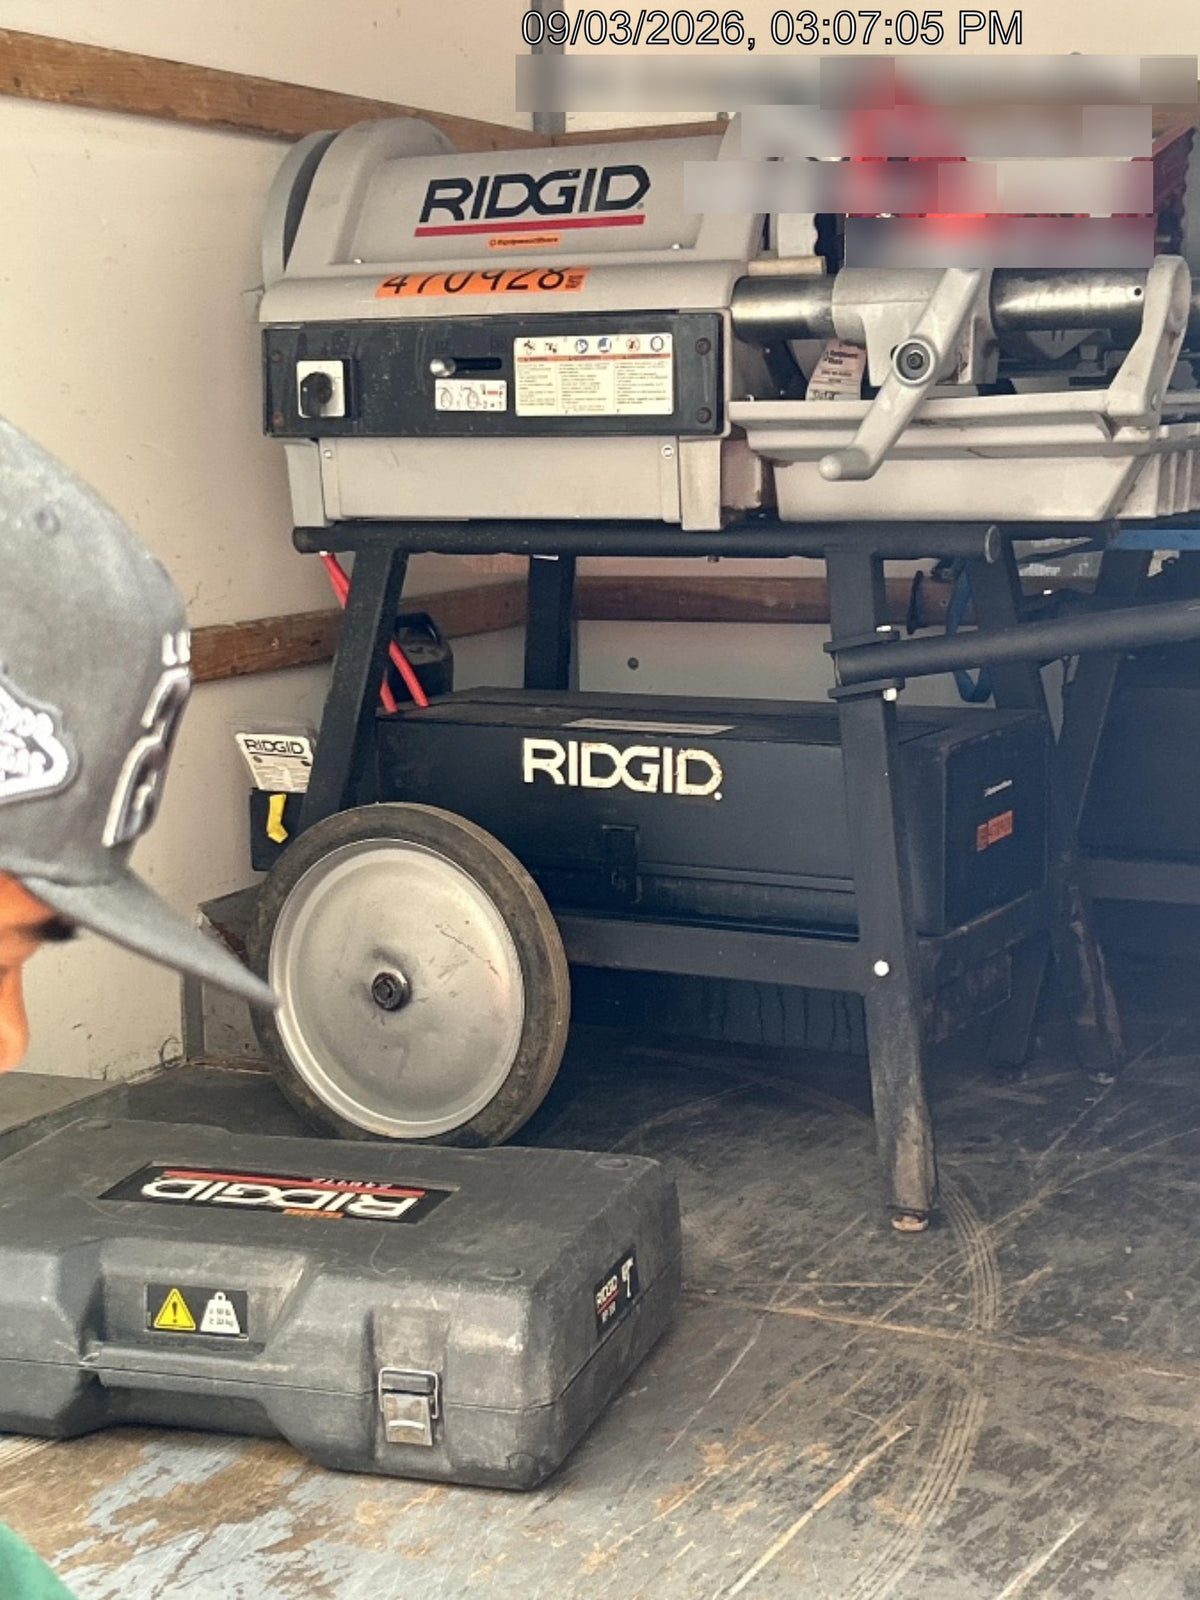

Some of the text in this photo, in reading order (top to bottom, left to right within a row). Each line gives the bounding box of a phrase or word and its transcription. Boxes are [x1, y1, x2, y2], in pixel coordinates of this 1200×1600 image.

[418, 164, 651, 223] RIDGID
[243, 738, 304, 755] RIDGID
[522, 737, 723, 800] RIDGID
[141, 1178, 418, 1218] RIDGID
